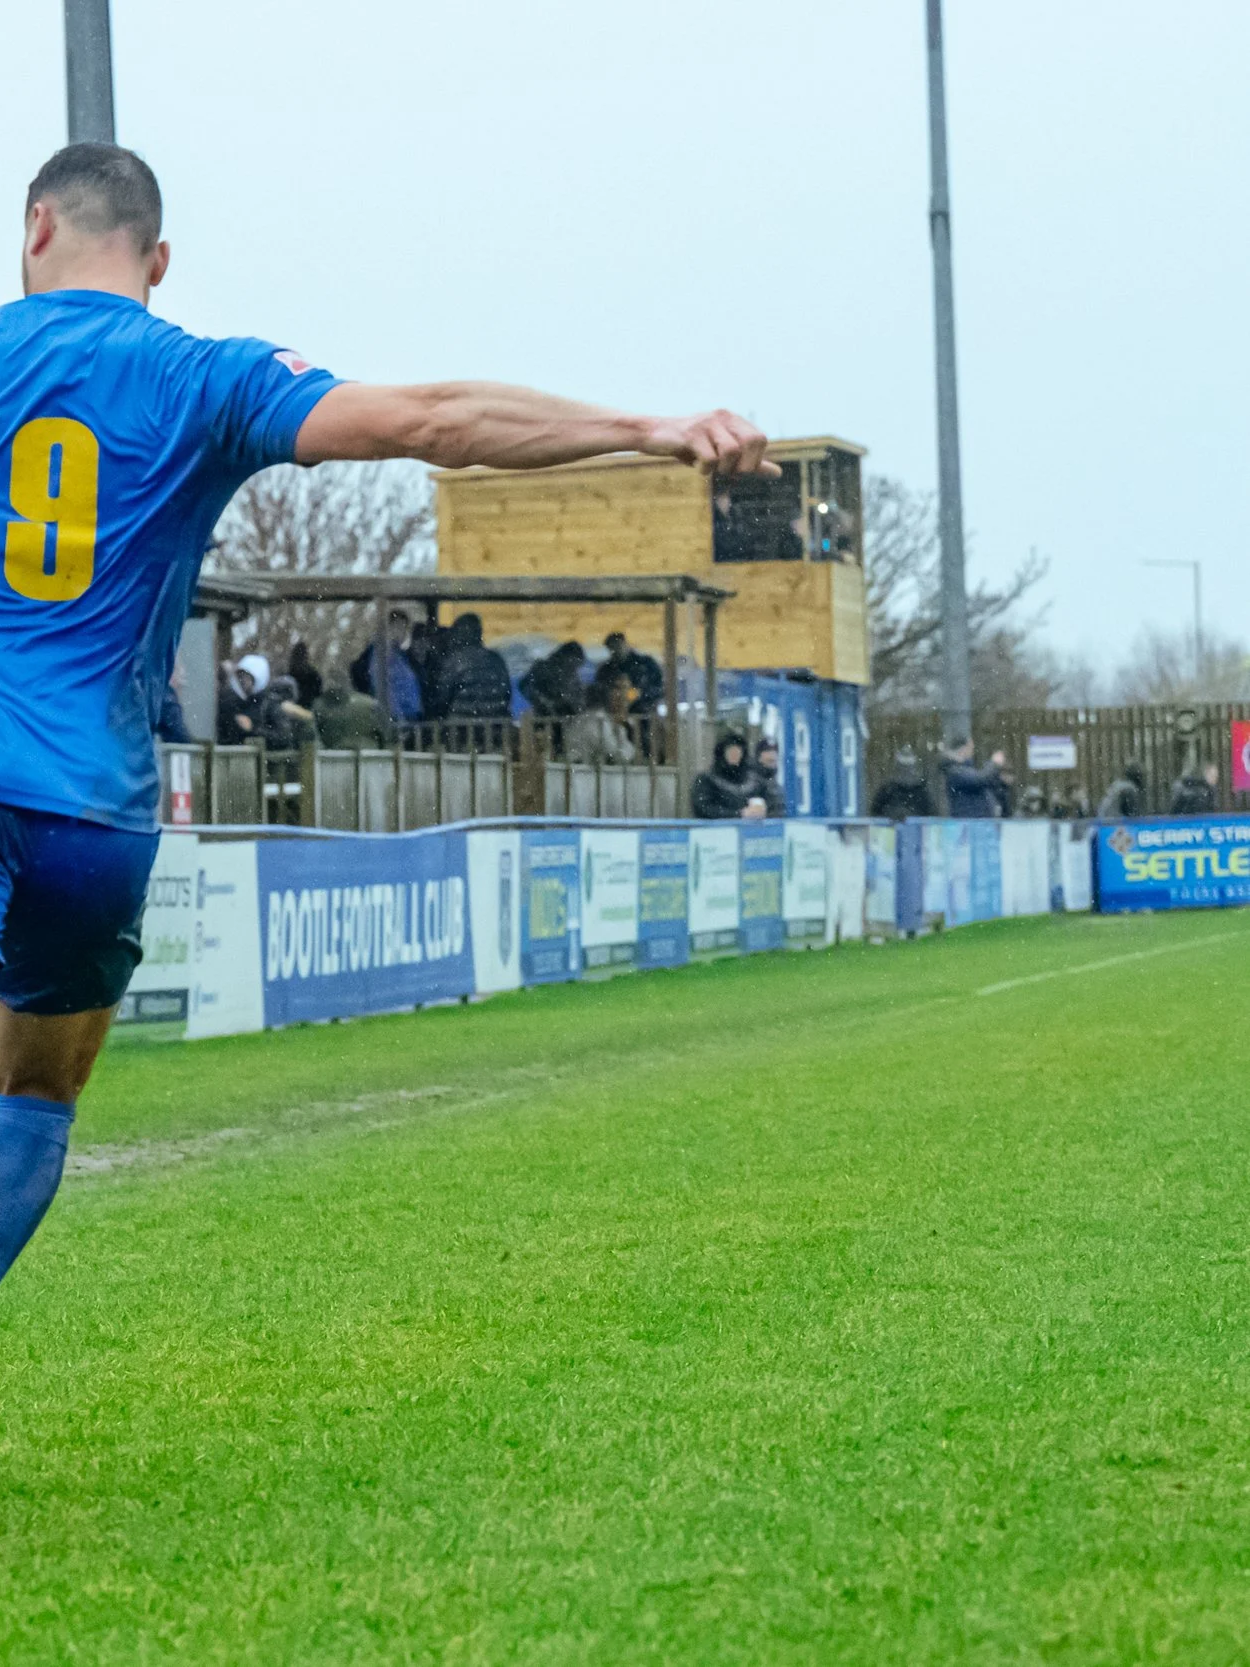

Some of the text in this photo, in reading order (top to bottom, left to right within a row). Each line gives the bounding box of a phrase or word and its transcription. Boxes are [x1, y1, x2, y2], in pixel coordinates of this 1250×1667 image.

[4, 416, 99, 602] 9
[1138, 828, 1205, 847] BERRY
[267, 888, 340, 982] BOOTLE
[340, 882, 423, 973] FOOTBALL
[424, 876, 464, 962] CLUB
